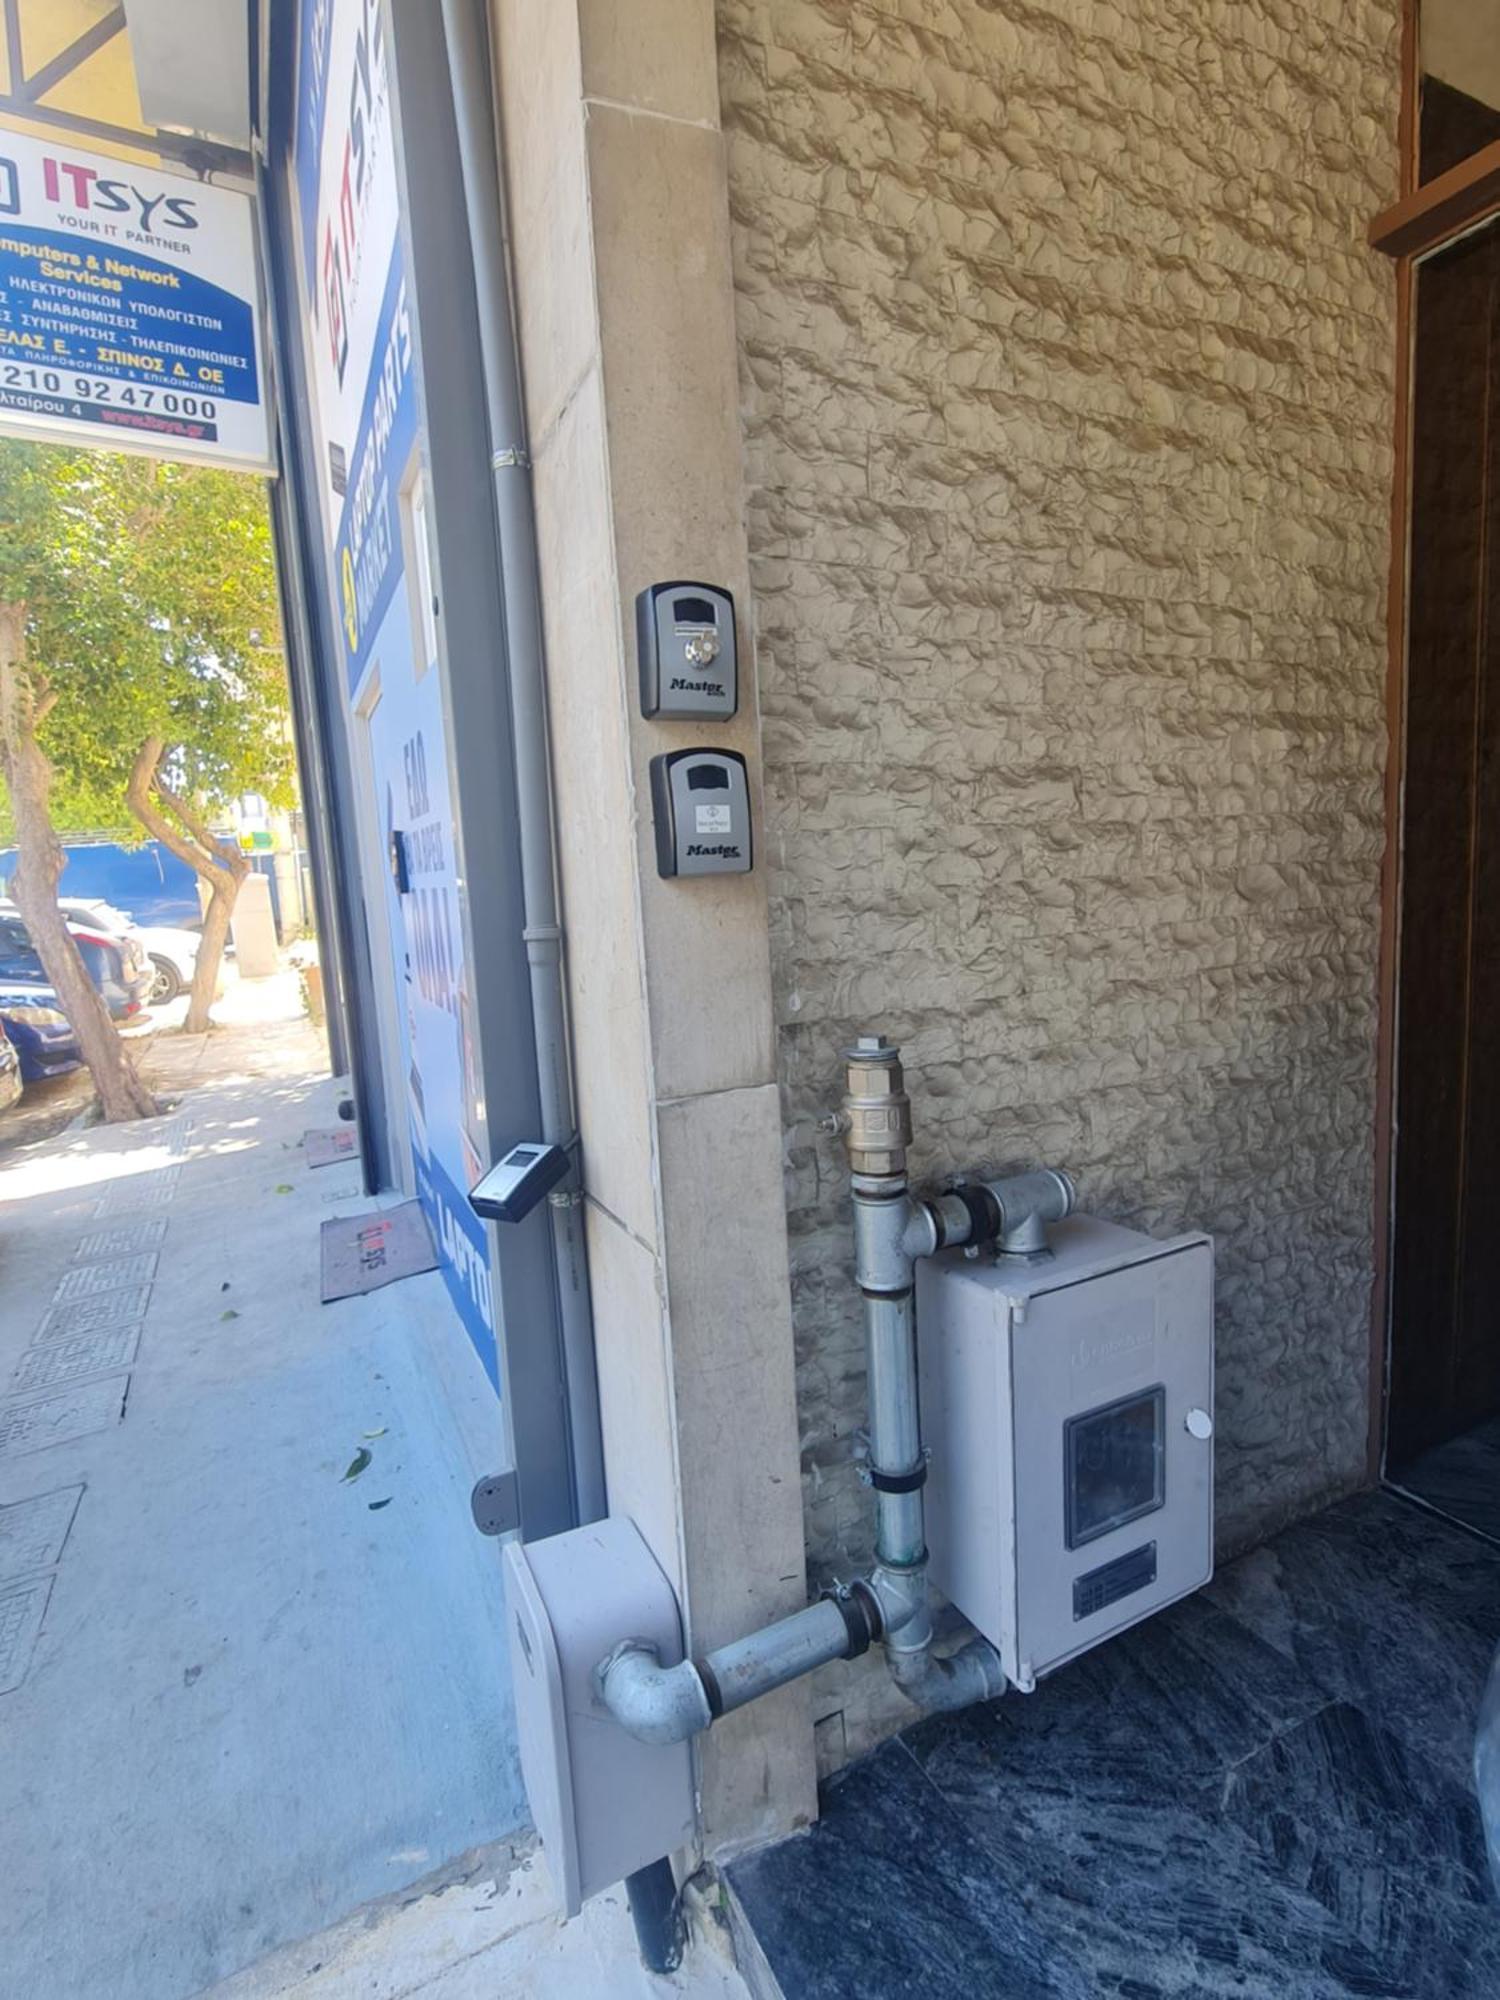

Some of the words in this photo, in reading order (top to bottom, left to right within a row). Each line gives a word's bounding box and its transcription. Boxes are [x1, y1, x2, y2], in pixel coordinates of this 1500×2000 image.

[43, 157, 198, 232] ITSYS
[57, 213, 100, 233] YOUR
[105, 224, 118, 237] IT
[126, 230, 191, 253] PARTNER
[0, 237, 81, 266] mputers
[86, 255, 100, 270] &
[105, 258, 181, 289] Network
[40, 260, 122, 292] Services
[9, 275, 121, 309] ΗΛΕΚΤΡΟΝΙΚΩΝ
[129, 301, 222, 331] ΥΠΟΛΟΓΙΣΤΩΝ
[32, 298, 138, 331] ΑΝΑΒΑΘΜΙΣΕΙΣ
[21, 313, 117, 344] ΣΥΝΤΗΡΗΣΗΣ
[130, 335, 248, 369] ΤΗΛΕΠΙΚΟΙΝΩΝΙΕΣ
[97, 347, 165, 373] ΣΠΙΝΟΣ
[199, 367, 224, 384] ΟΕ
[373, 276, 411, 472] PARTS
[3, 365, 60, 392] 210
[163, 394, 216, 419] 000
[72, 403, 82, 416] 4
[670, 678, 723, 693] Master
[686, 844, 738, 857] Master
